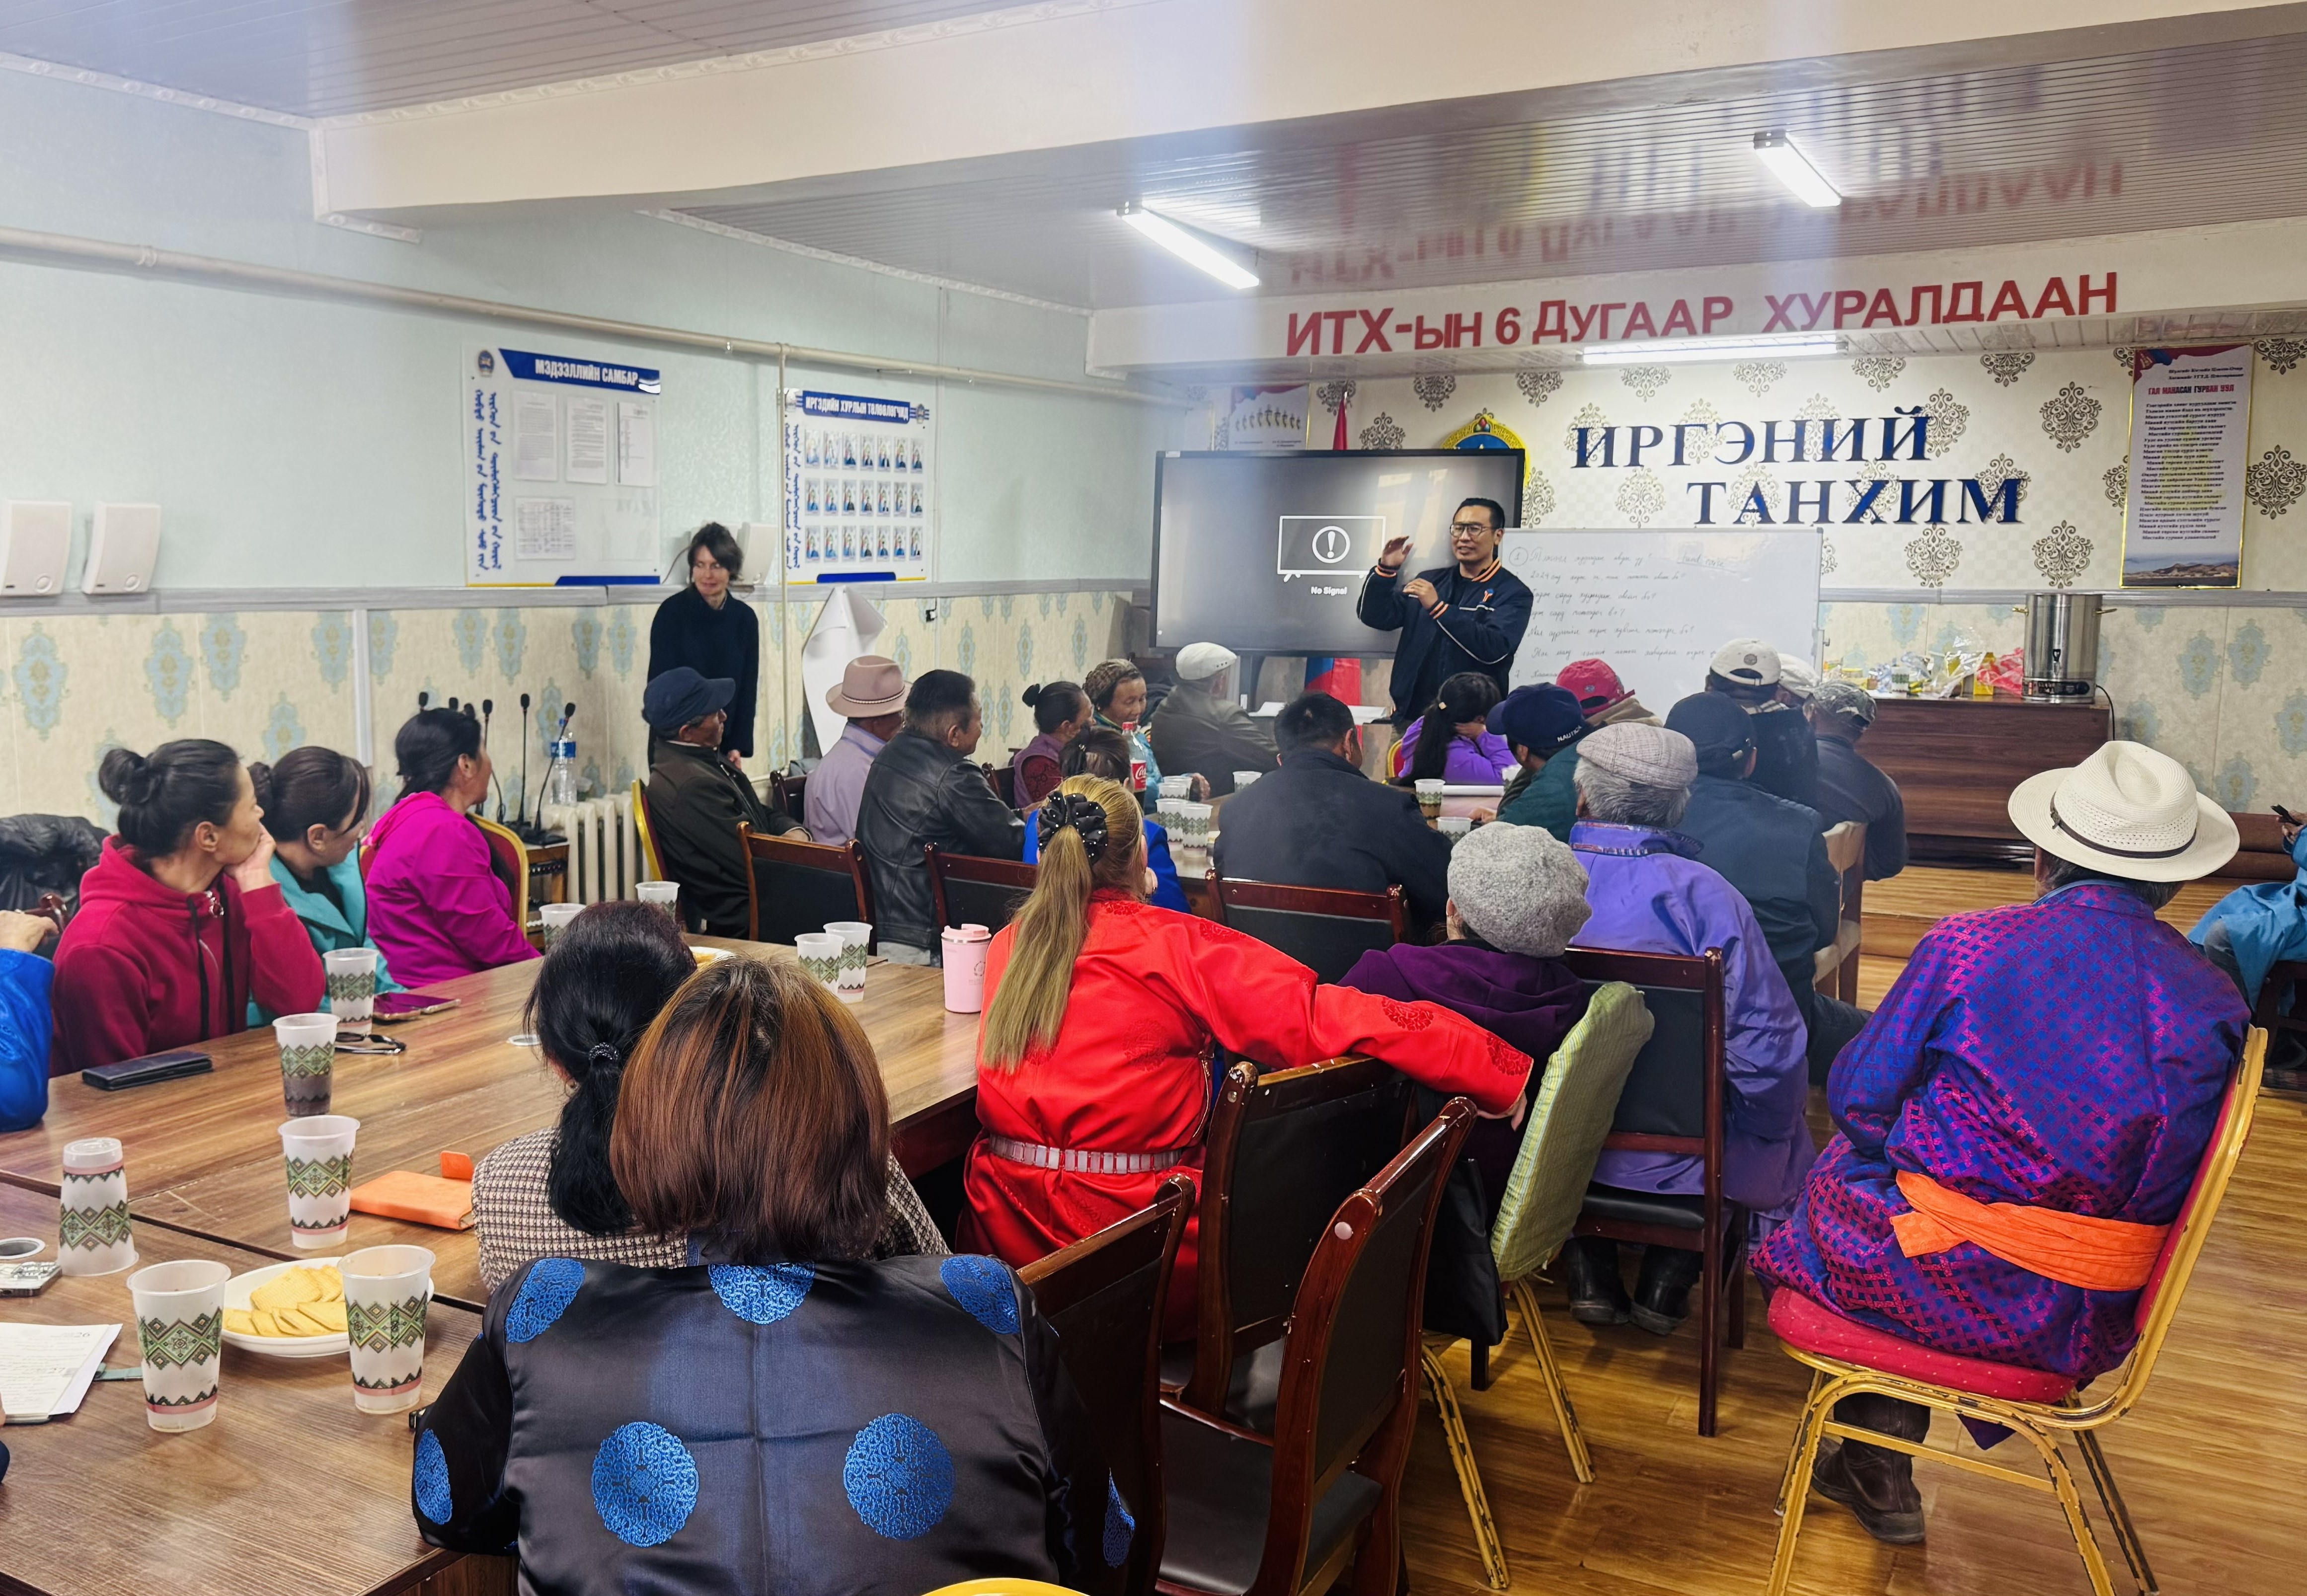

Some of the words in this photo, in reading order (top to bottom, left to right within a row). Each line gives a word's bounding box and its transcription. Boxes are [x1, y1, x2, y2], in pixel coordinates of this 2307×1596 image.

[1495, 307, 1521, 345] 6
[1533, 296, 1733, 344] ДУГААР
[1762, 272, 2117, 333] ХУРАЛДААН
[602, 368, 638, 386] САМБАР
[2194, 384, 2219, 393] ГУРВАН
[806, 396, 840, 413] ИРГЭДИЙН
[841, 400, 867, 414] ХУРЛЫН
[1570, 405, 1932, 468] ИРГЭНИЙ
[1687, 478, 2025, 525] ТАНХИМ
[1323, 587, 1347, 596] Signal
